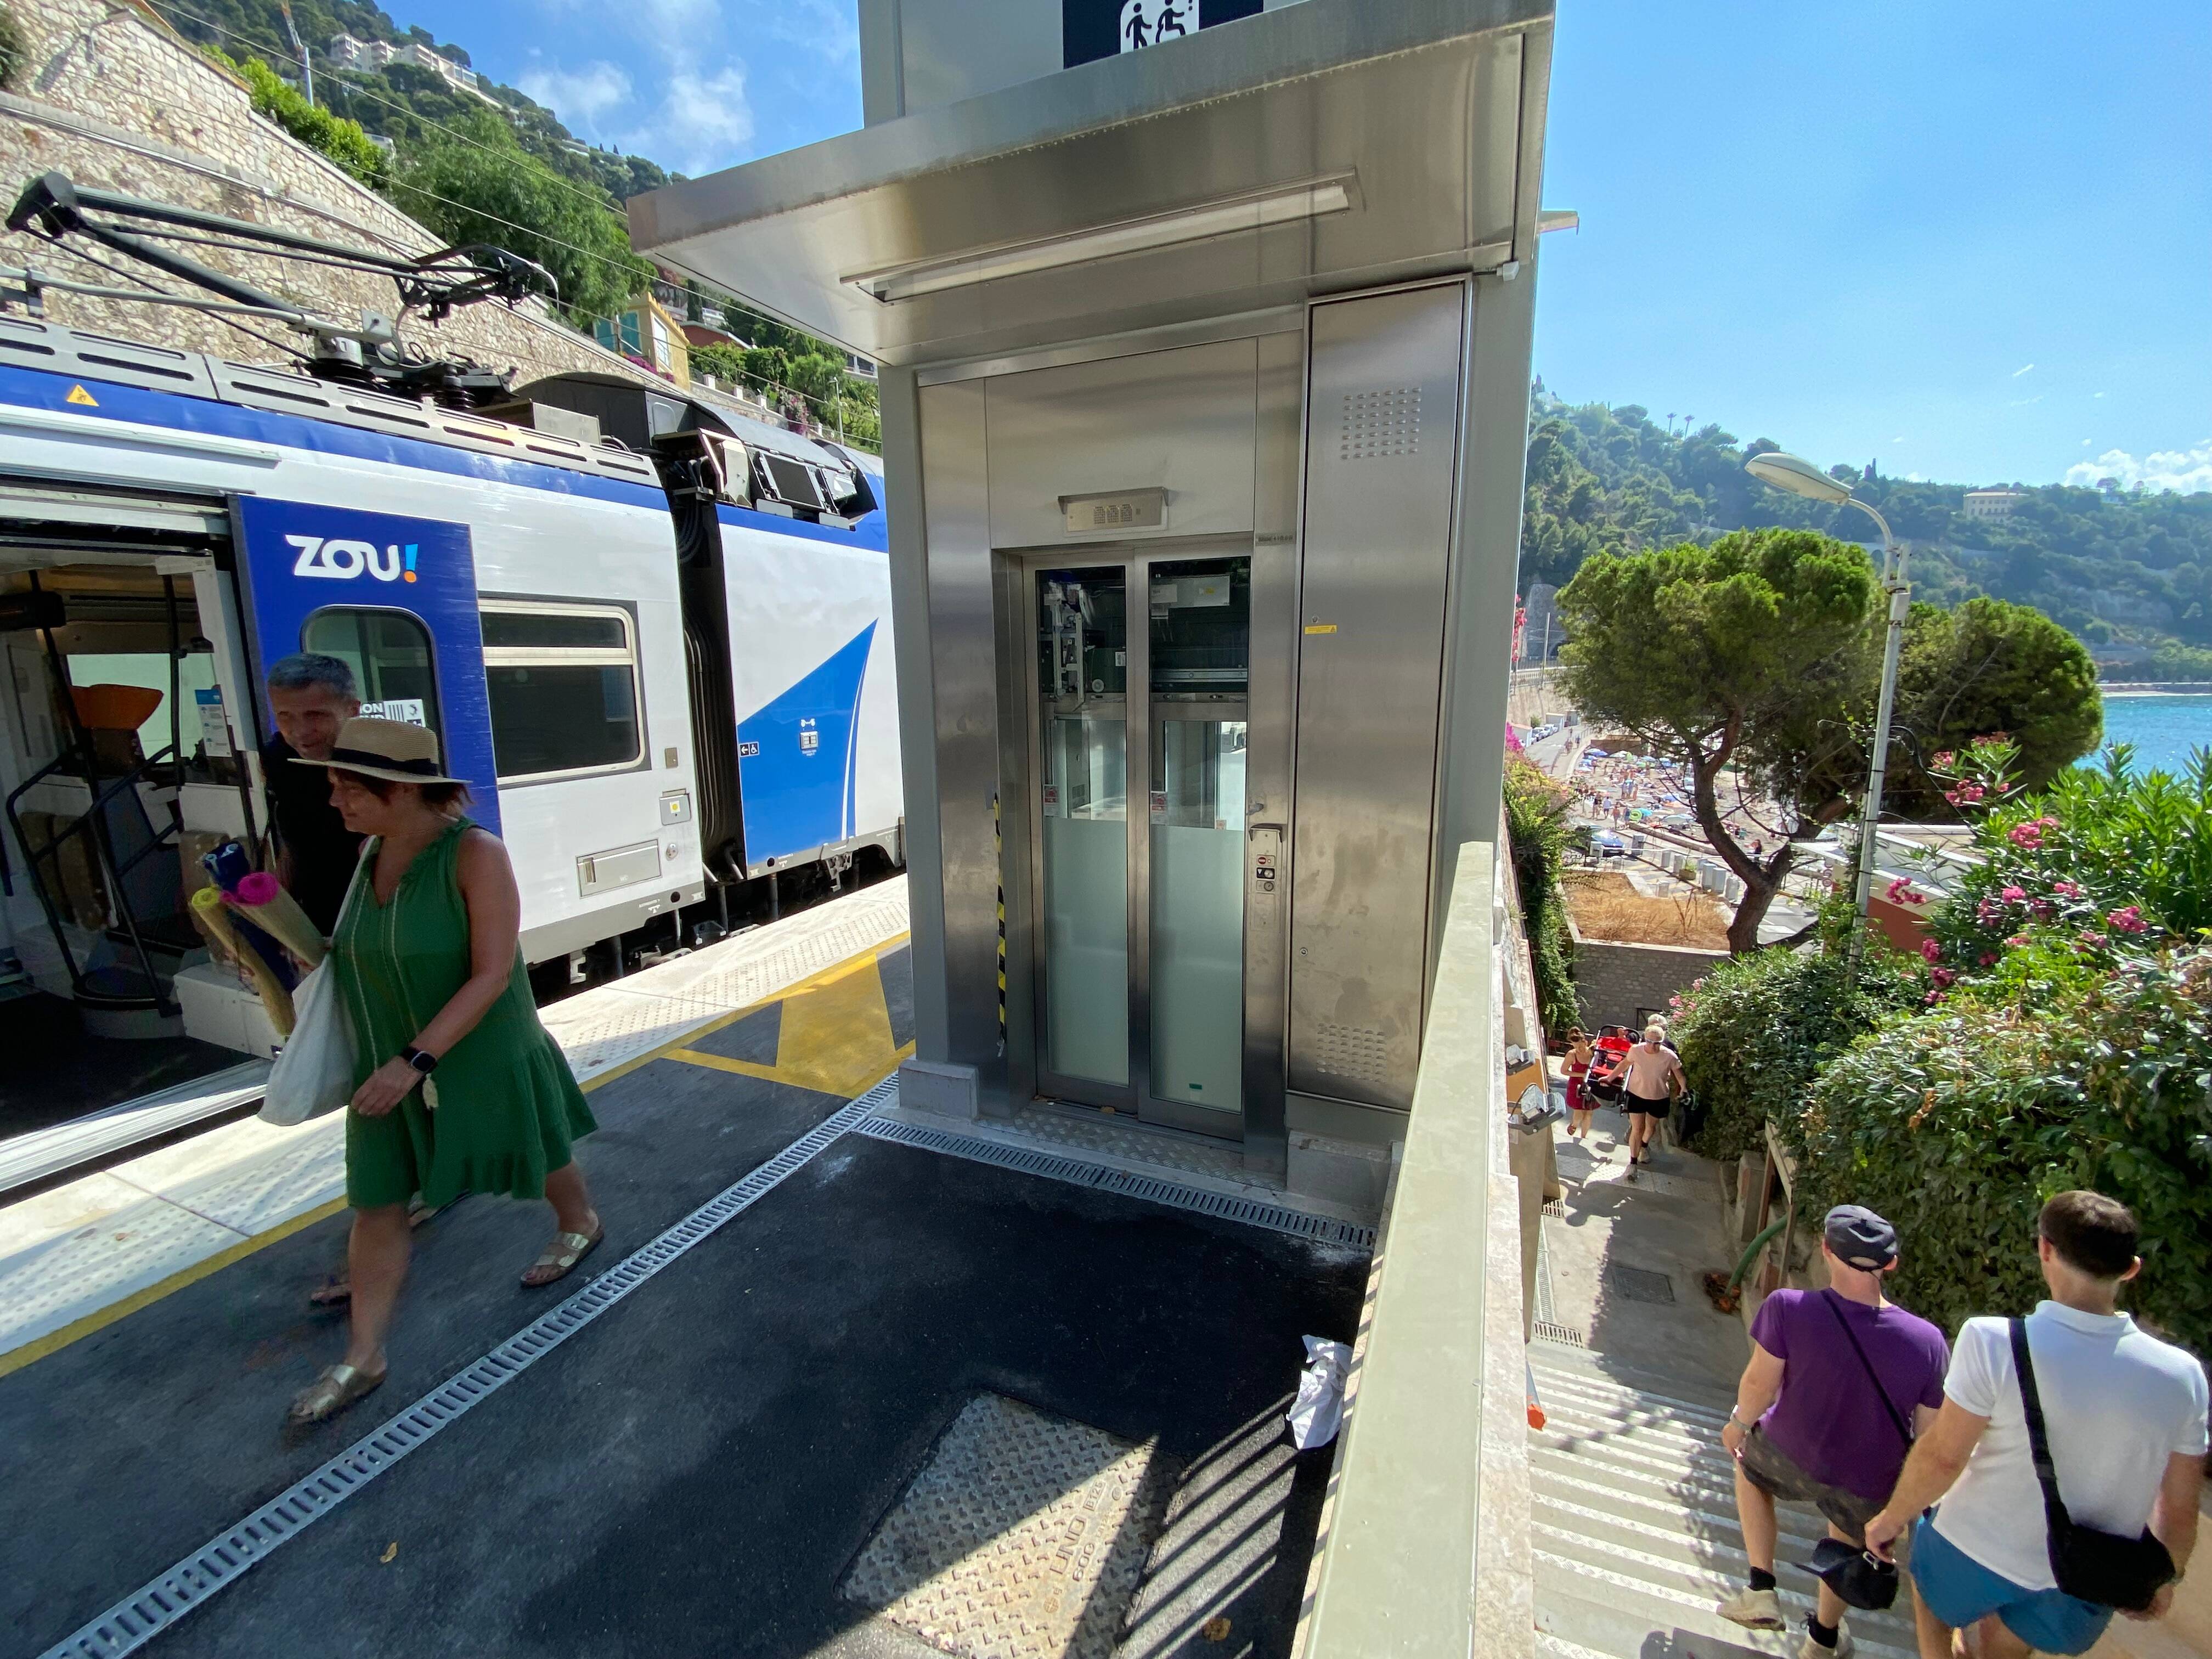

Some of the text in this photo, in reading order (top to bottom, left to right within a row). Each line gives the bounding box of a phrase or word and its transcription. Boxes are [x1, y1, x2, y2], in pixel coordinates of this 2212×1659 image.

[285, 534, 419, 583] ZOU!
[1086, 1481, 1103, 1508] B125
[1049, 1515, 1087, 1575] UNO
[1072, 1542, 1095, 1582] 600
